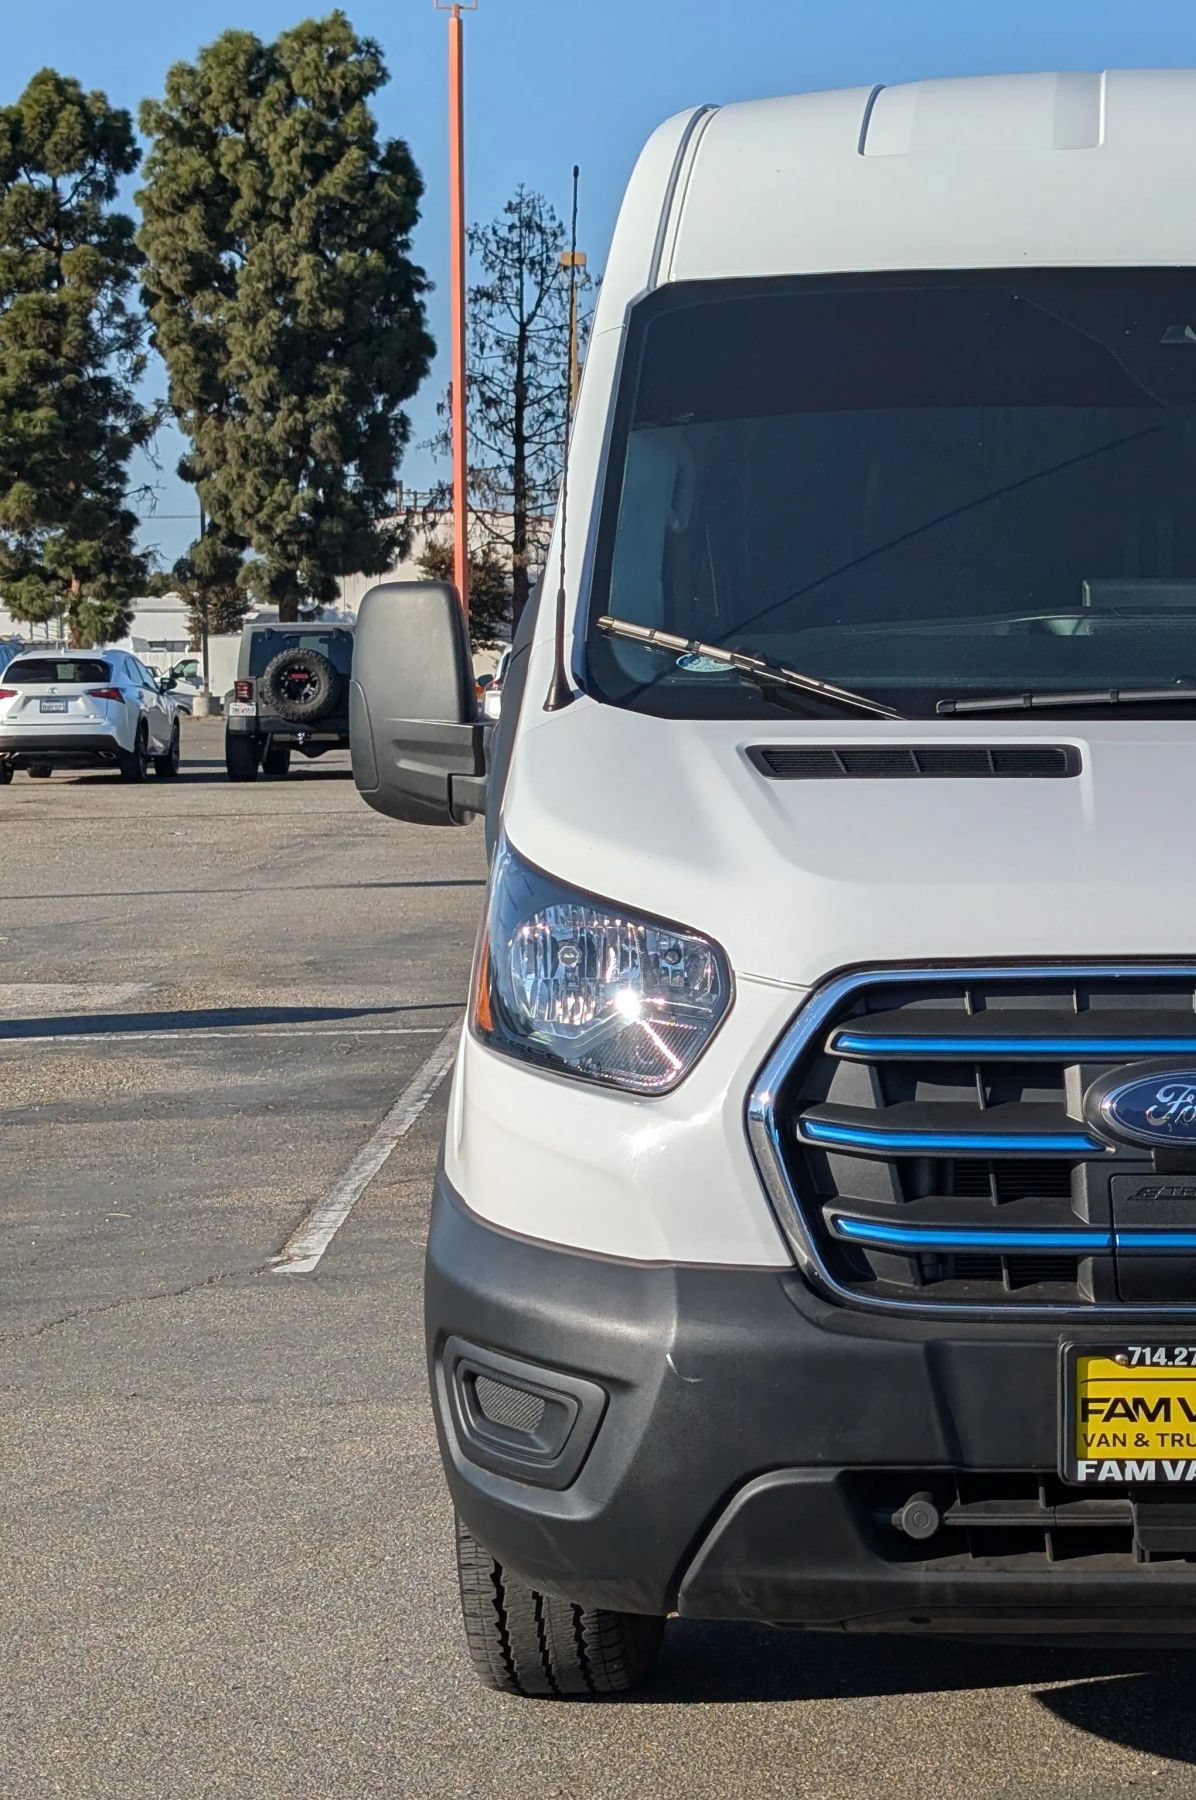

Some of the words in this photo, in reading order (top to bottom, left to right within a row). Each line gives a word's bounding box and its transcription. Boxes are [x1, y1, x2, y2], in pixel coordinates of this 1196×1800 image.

[1080, 1397, 1171, 1423] FAM
[1081, 1433, 1128, 1448] VAN
[1133, 1432, 1150, 1447] &
[1077, 1460, 1155, 1481] FAM
